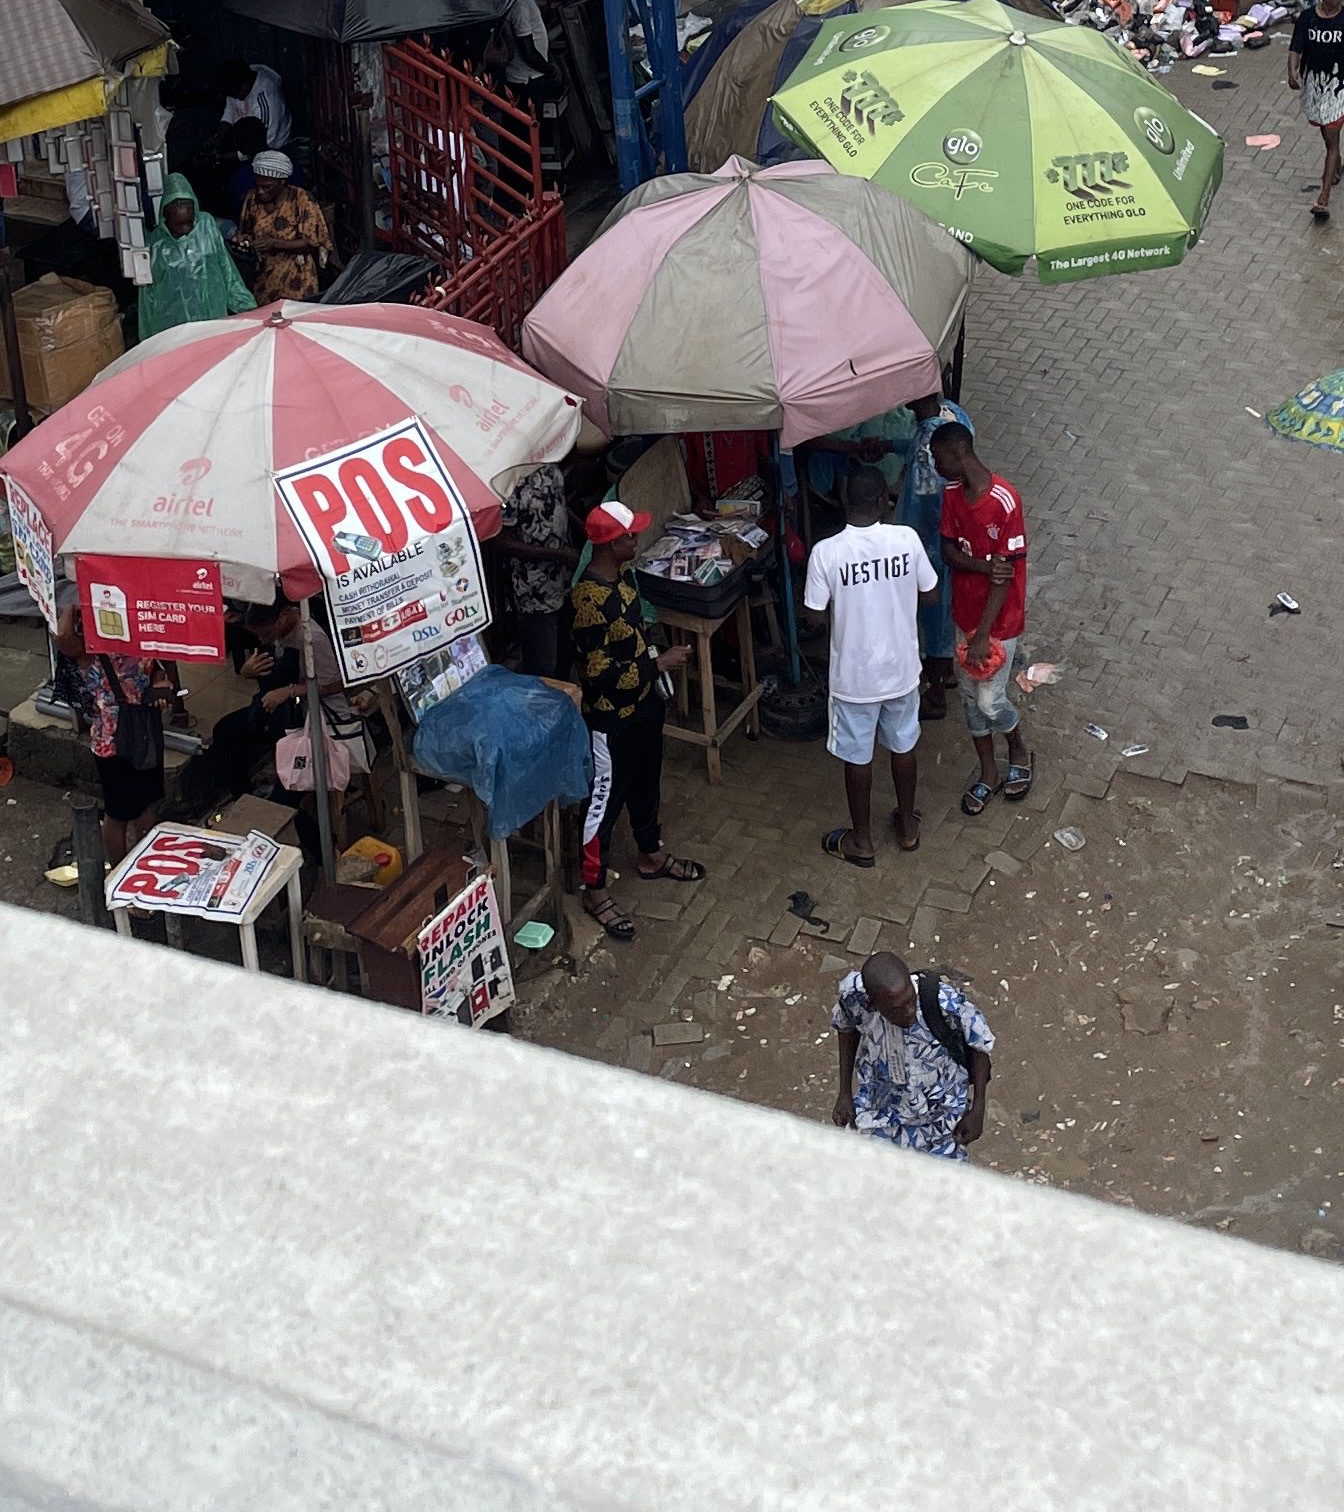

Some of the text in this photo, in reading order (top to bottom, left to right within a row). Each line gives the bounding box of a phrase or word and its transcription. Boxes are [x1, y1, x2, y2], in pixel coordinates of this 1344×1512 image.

[1308, 28, 1343, 43] DIOR
[808, 100, 858, 158] EVERYTHING GLO
[823, 97, 866, 146] ONE CODE FOR
[1146, 117, 1165, 147] glo
[947, 134, 979, 158] glo
[1172, 138, 1196, 181] Unlimited
[1063, 206, 1147, 226] EVERYTHING GLO
[1065, 195, 1136, 211] ONE CODE FOR
[947, 225, 974, 244] AND
[1050, 244, 1171, 271] The Largest 4G Network
[475, 397, 510, 433] airtel
[152, 494, 215, 518] airtel
[291, 437, 454, 577] POS
[110, 517, 129, 529] THE
[197, 525, 244, 539] NETWORK
[336, 541, 425, 589] IS AVAILABLE
[839, 552, 910, 587] VESTIGE
[192, 579, 214, 591] airtel
[338, 572, 401, 603] CASH WITHDRAWAL
[341, 600, 366, 614] MONEY
[366, 587, 401, 607] TRANSFER
[406, 569, 434, 588] DEPOSIT
[136, 599, 216, 614] REGISTER YOUR
[137, 611, 187, 625] SIM CARD
[344, 597, 404, 626] PAYMENT OF BILLS
[138, 622, 166, 634] HERE
[118, 835, 208, 900] POS
[420, 881, 488, 952] REPAIR
[424, 912, 492, 987] FLASH
[438, 965, 456, 986] KIND
